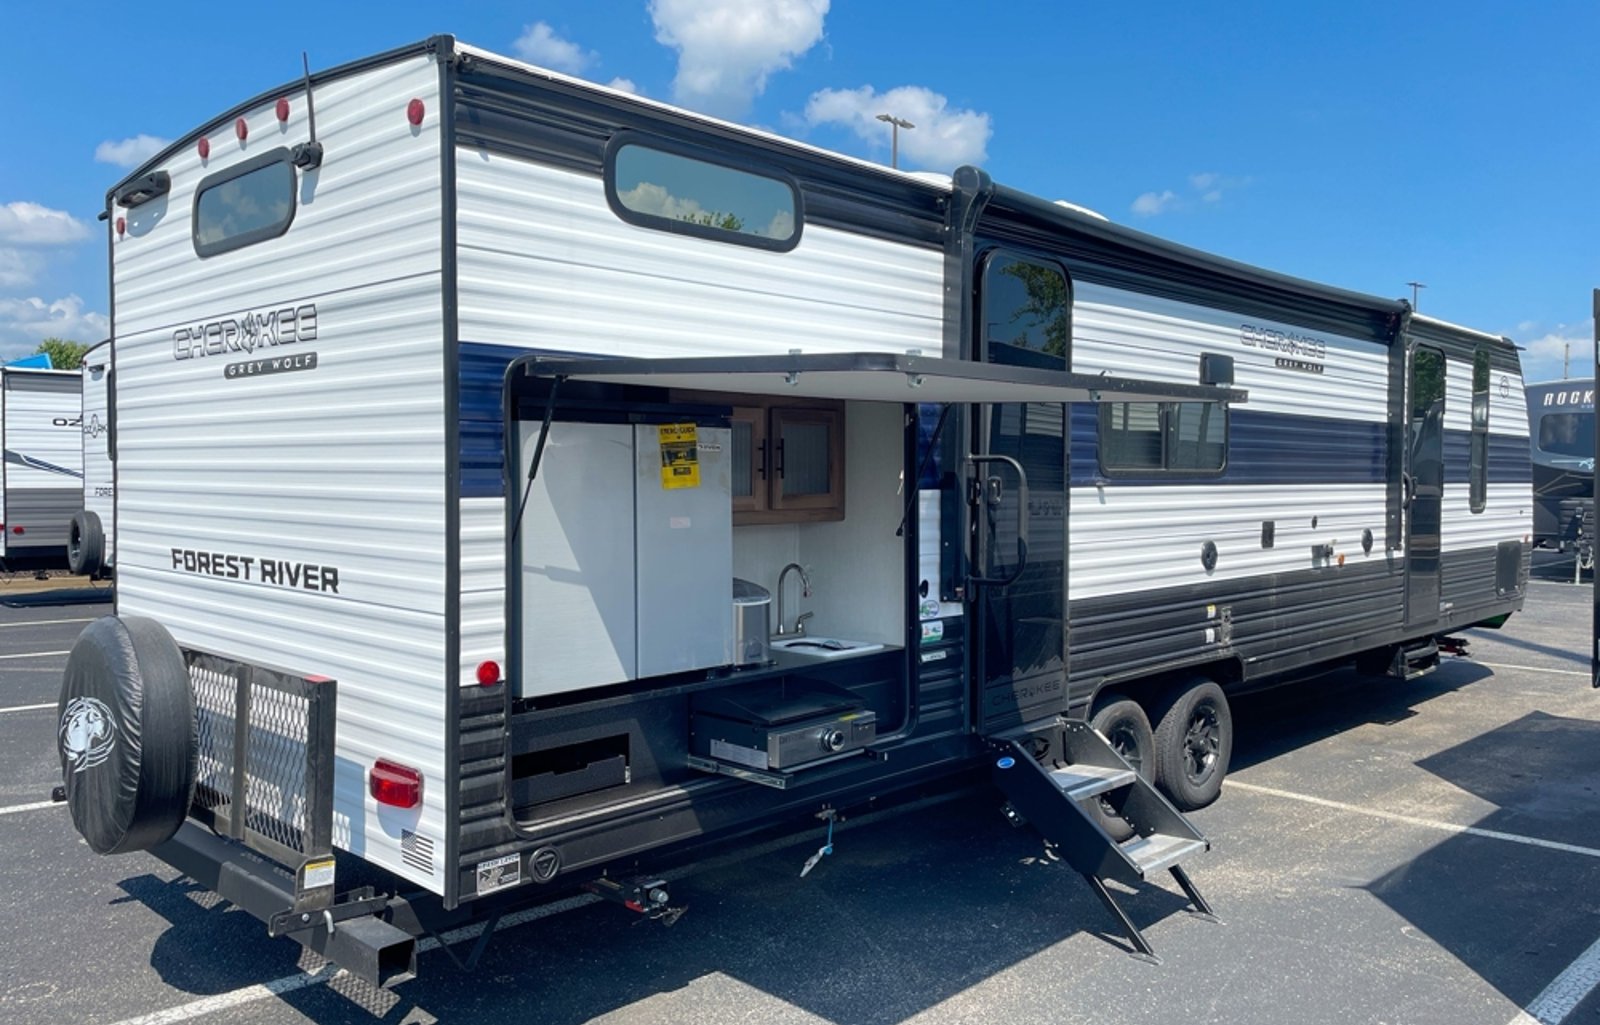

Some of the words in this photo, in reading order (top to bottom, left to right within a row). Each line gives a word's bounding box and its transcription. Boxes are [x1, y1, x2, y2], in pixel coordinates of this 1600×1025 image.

[228, 362, 263, 376] GREY
[272, 354, 312, 370] WOLF
[1277, 359, 1298, 367] GREY
[1302, 363, 1322, 371] WOLF
[171, 548, 254, 580] FOREST
[260, 558, 339, 594] RIVER
